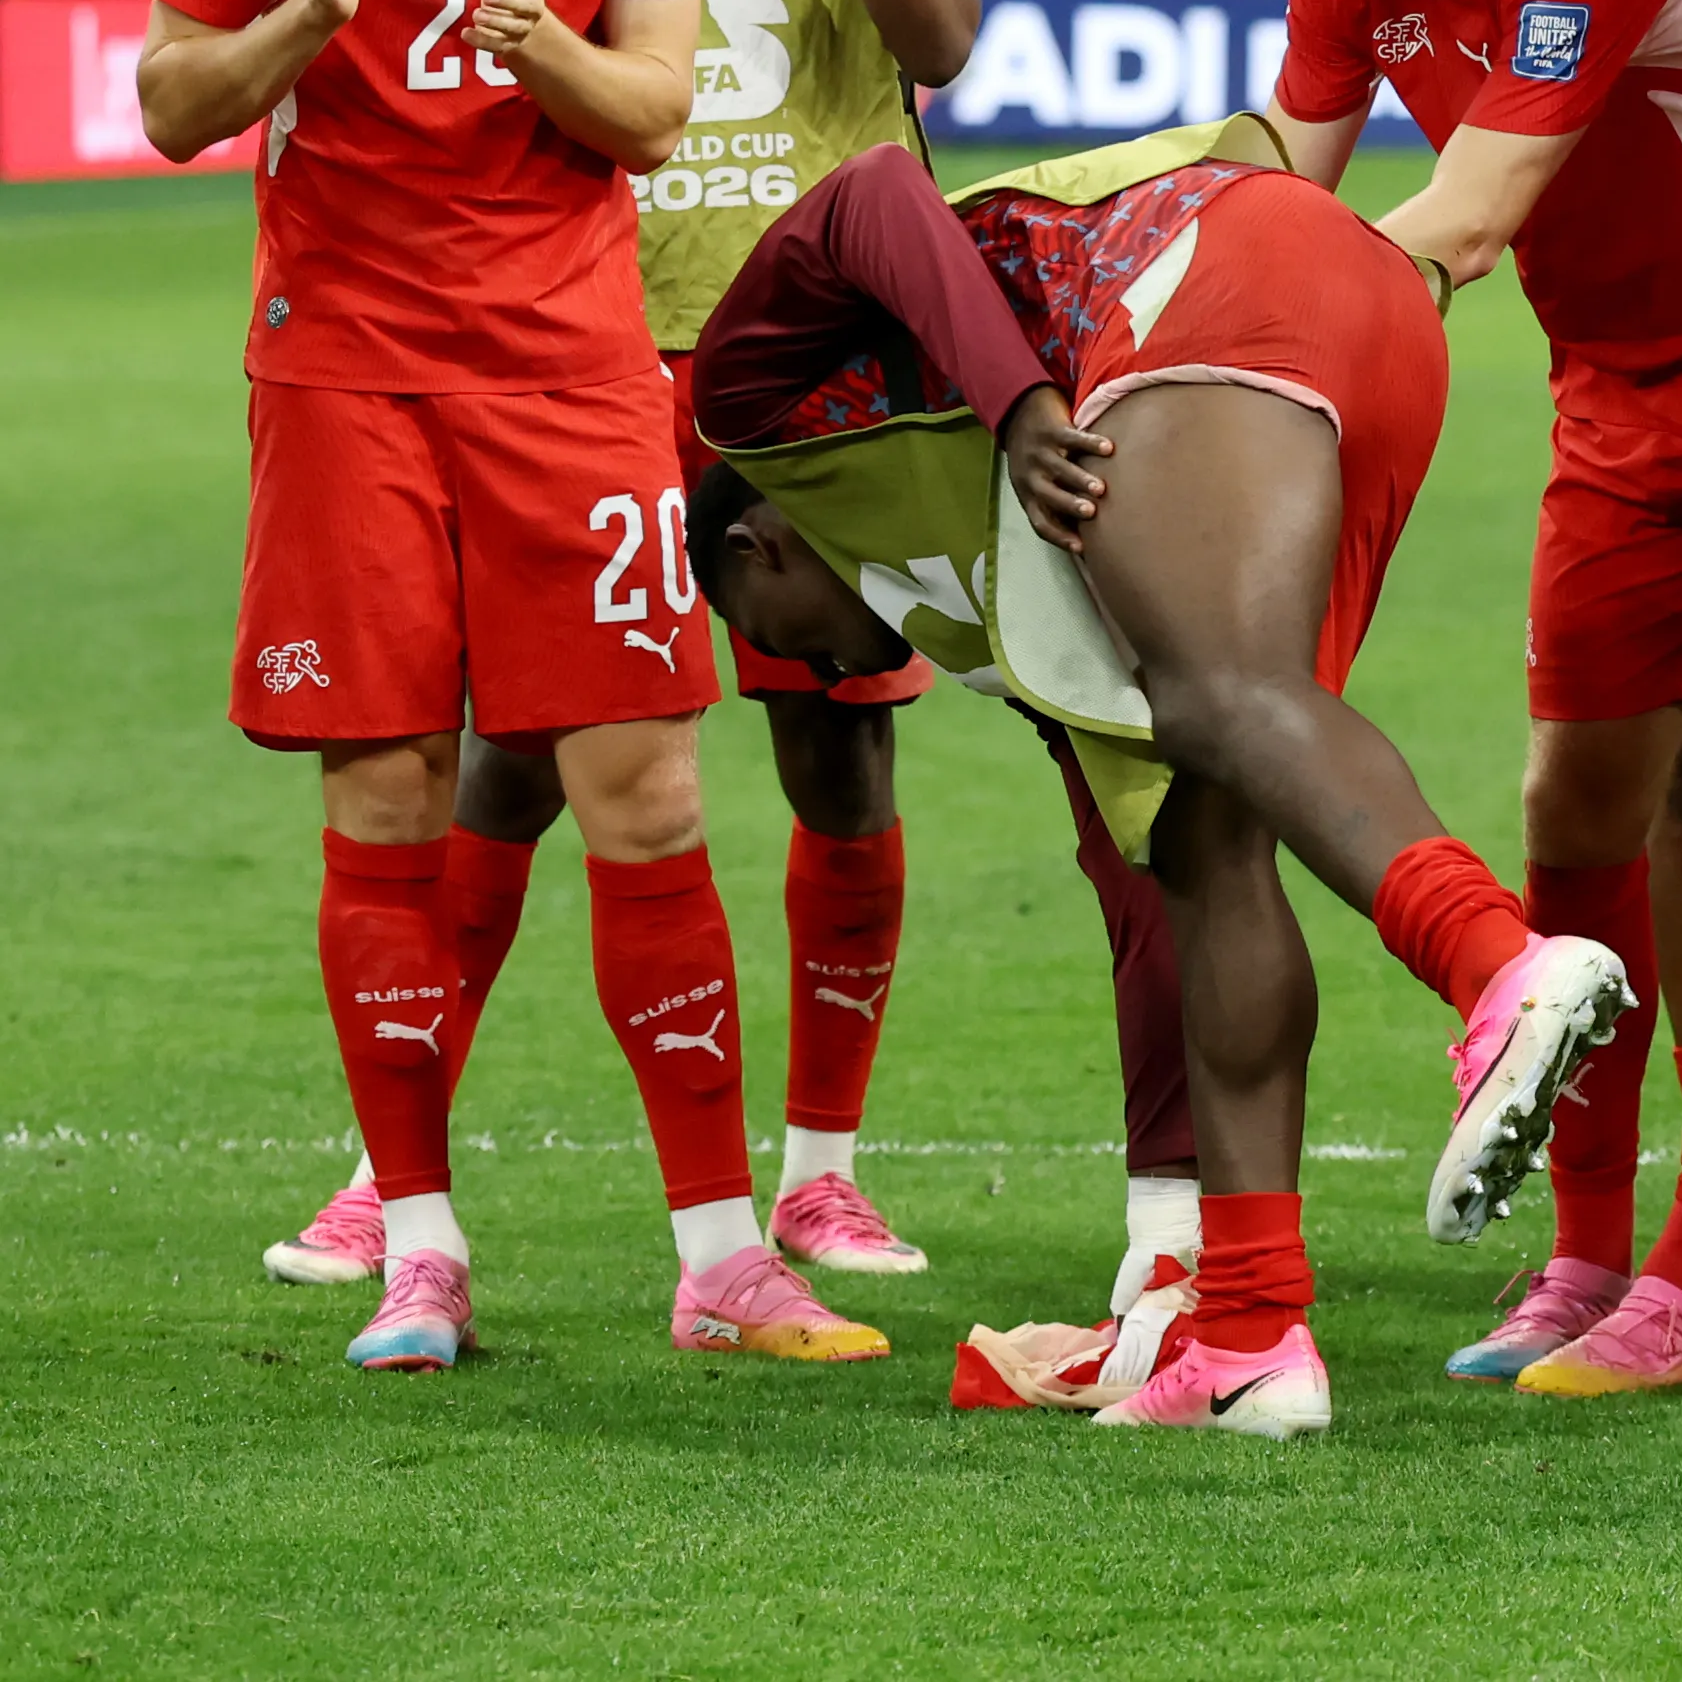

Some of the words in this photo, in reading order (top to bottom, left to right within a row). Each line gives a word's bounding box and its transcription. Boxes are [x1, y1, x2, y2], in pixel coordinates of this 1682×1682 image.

[1528, 28, 1576, 46] UNITES
[1530, 15, 1577, 30] FOOTBALL
[1533, 59, 1554, 68] FIFA
[694, 64, 742, 94] FA
[668, 136, 725, 163] RLD
[731, 133, 795, 159] CUP
[628, 164, 798, 213] 2026
[589, 487, 698, 624] 20
[355, 987, 444, 1003] suisse
[628, 979, 723, 1026] suisse
